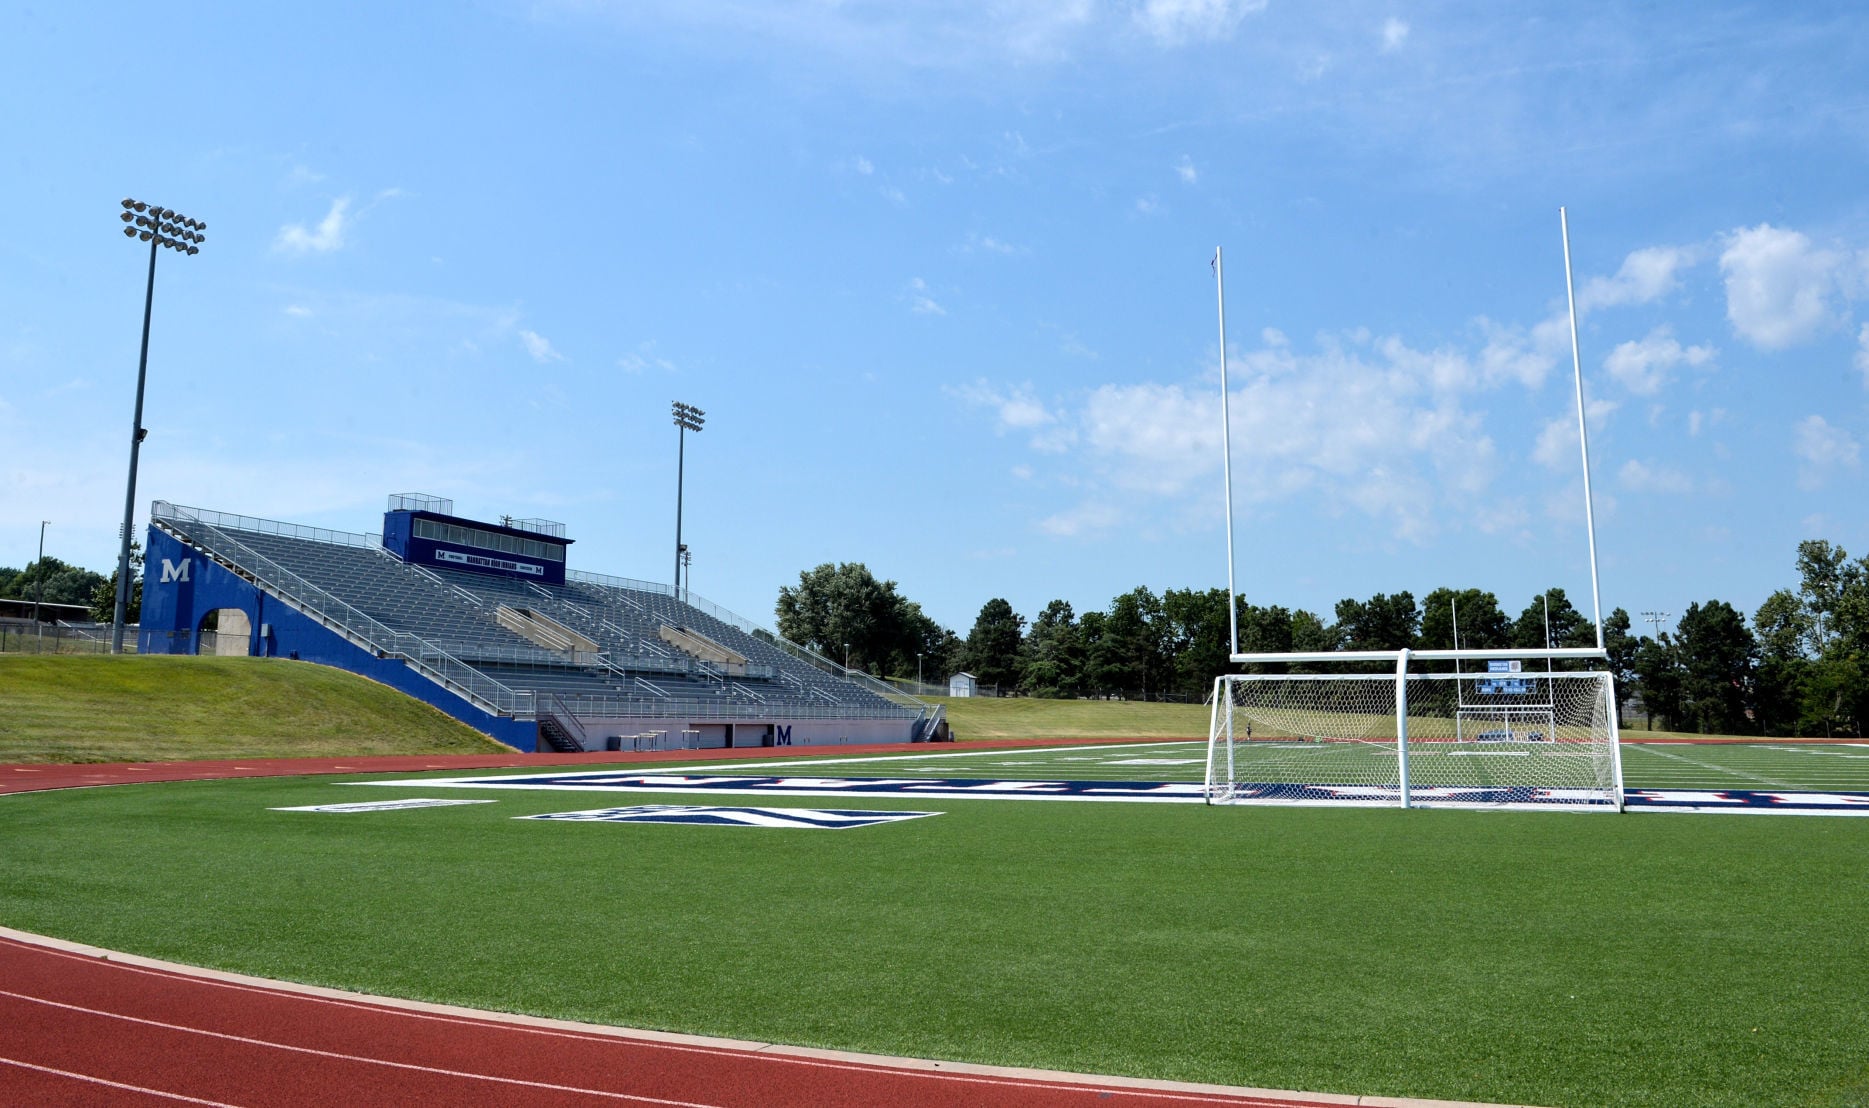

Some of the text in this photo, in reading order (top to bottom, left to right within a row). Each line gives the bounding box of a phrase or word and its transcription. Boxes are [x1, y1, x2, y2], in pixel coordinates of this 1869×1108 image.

[438, 551, 445, 559] M
[160, 558, 191, 582] M
[777, 725, 791, 745] M
